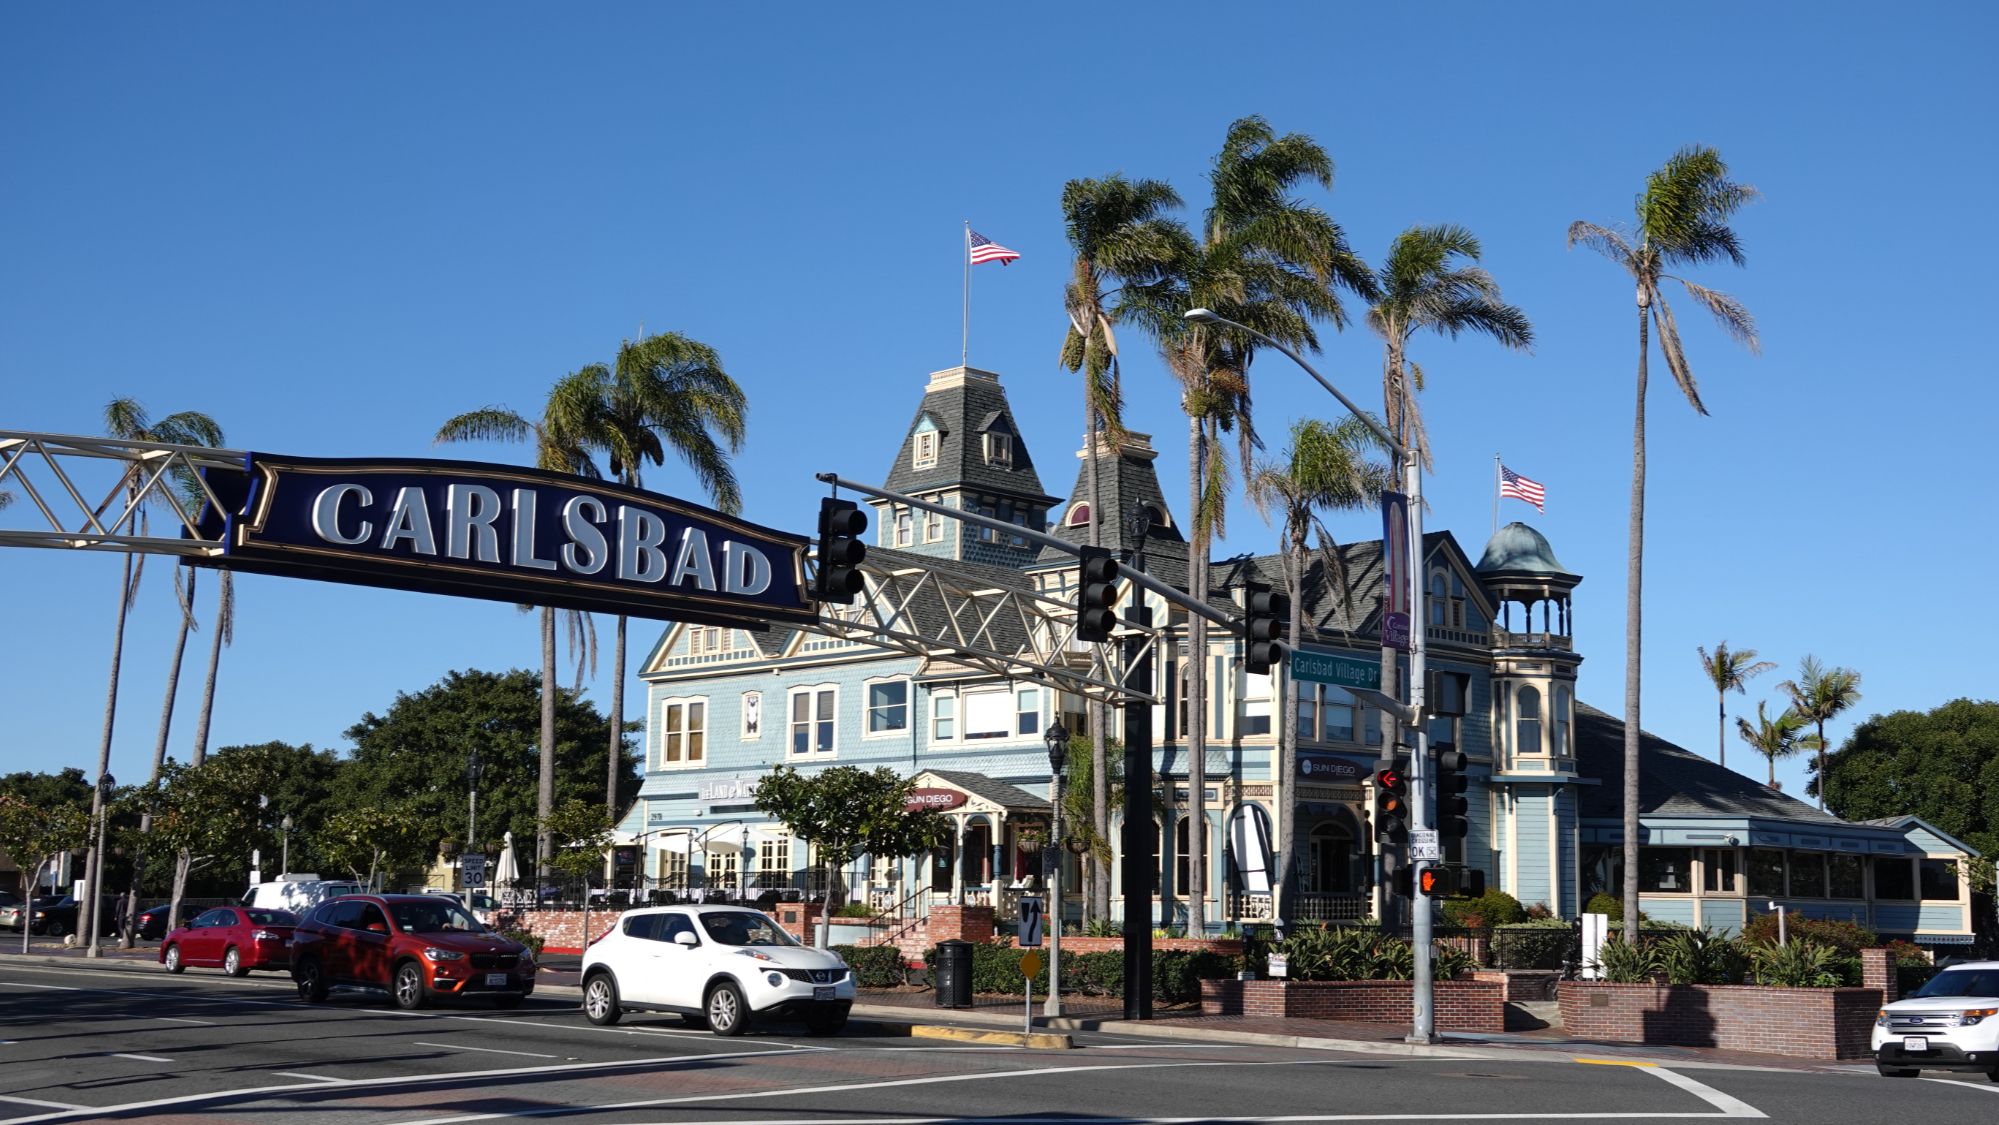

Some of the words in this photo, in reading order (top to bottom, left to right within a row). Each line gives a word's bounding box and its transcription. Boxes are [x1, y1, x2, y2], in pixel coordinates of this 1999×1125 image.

[311, 483, 773, 596] CARLSBAD
[1294, 657, 1333, 677] Carlsbad
[1335, 662, 1365, 684] Village
[1367, 667, 1378, 682] Dr
[1312, 763, 1330, 773] SUN
[1330, 764, 1355, 776] DIEGO
[926, 794, 953, 806] DIEGO
[1411, 846, 1425, 857] OK
[464, 872, 483, 885] 30
